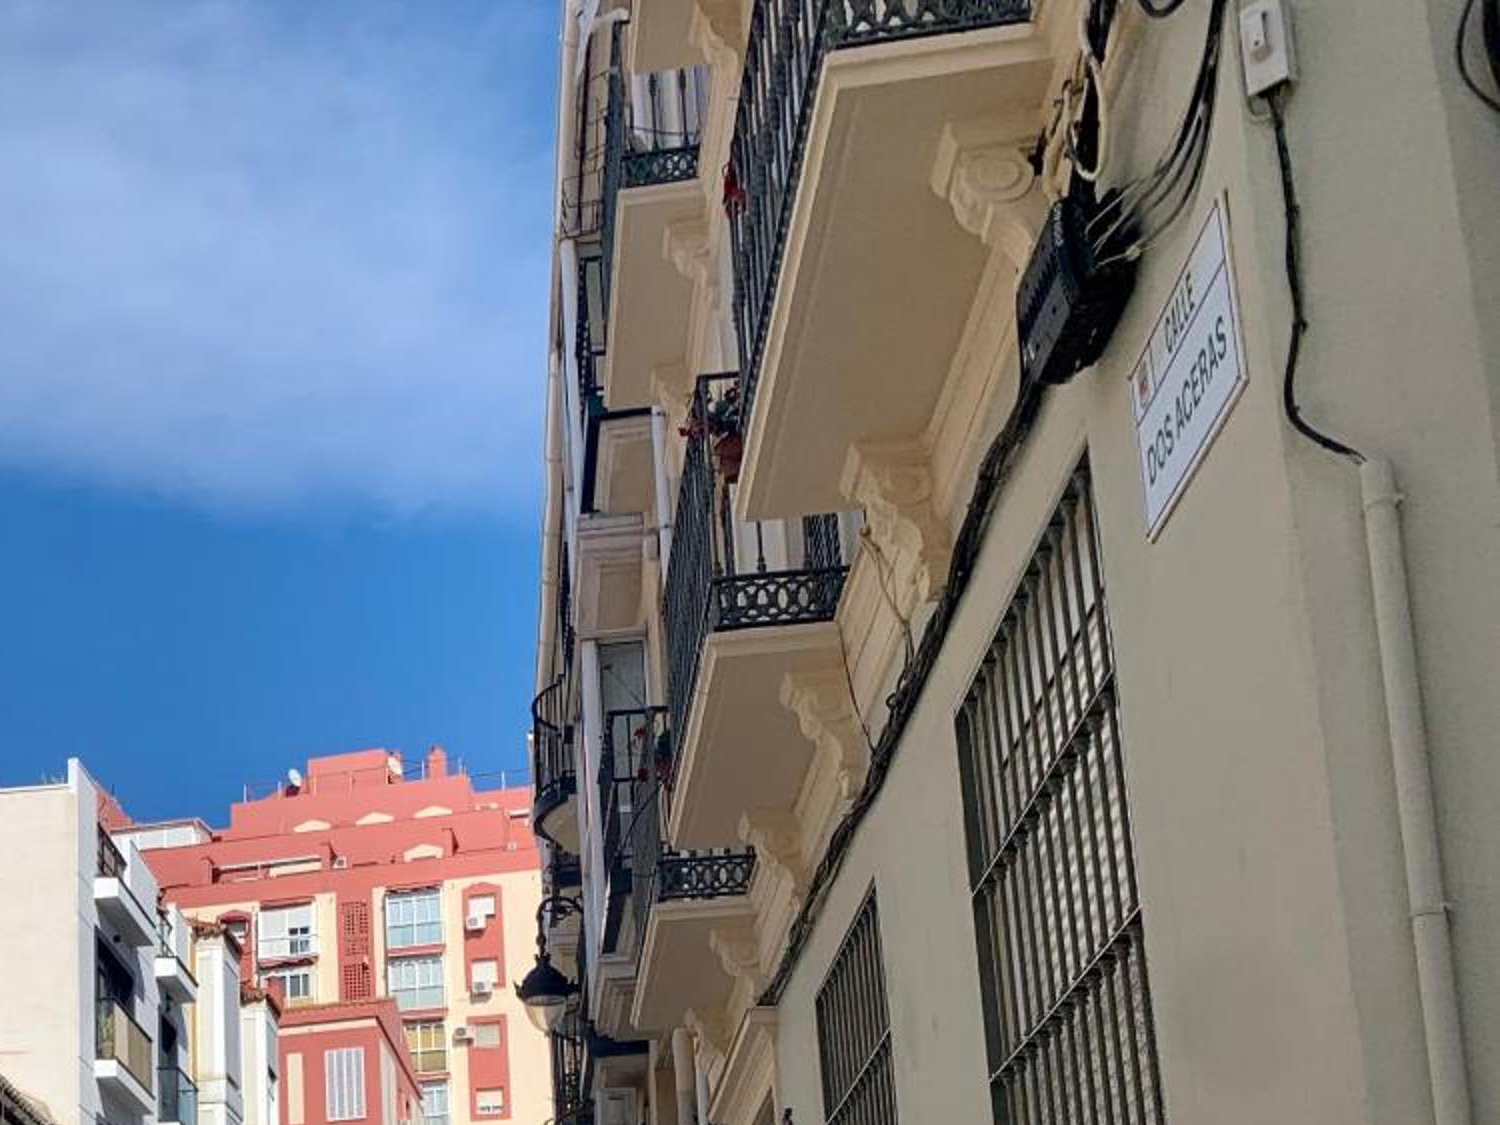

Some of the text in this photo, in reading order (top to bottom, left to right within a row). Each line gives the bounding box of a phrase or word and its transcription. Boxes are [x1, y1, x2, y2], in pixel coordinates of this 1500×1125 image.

[1163, 272, 1196, 354] CALLE
[1146, 314, 1228, 485] DOS ACERAS
